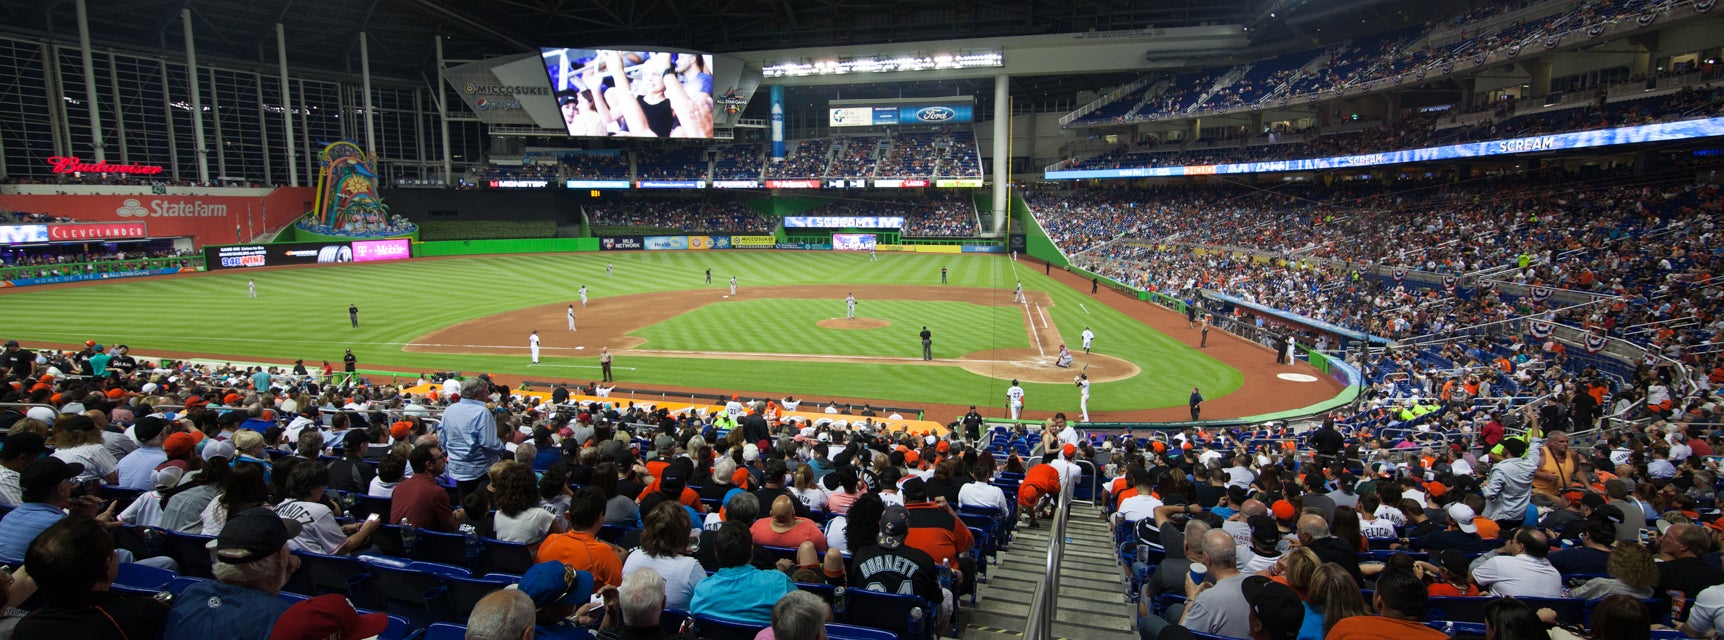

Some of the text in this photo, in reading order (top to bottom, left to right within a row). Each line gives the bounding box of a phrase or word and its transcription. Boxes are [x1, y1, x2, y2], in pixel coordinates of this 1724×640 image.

[477, 85, 549, 96] MICCOSUKEE
[923, 108, 948, 120] Ford
[1499, 136, 1554, 153] SCREAM
[47, 155, 163, 175] Budweiser
[1348, 154, 1382, 165] SCREAM
[499, 180, 548, 188] MONSTER
[153, 186, 166, 194] 427
[817, 216, 863, 227] SCREAM
[52, 225, 143, 240] CLEVELANDER
[839, 242, 872, 251] SCREAM
[221, 255, 265, 267] 940 WINZ
[859, 554, 920, 579] BURNETT
